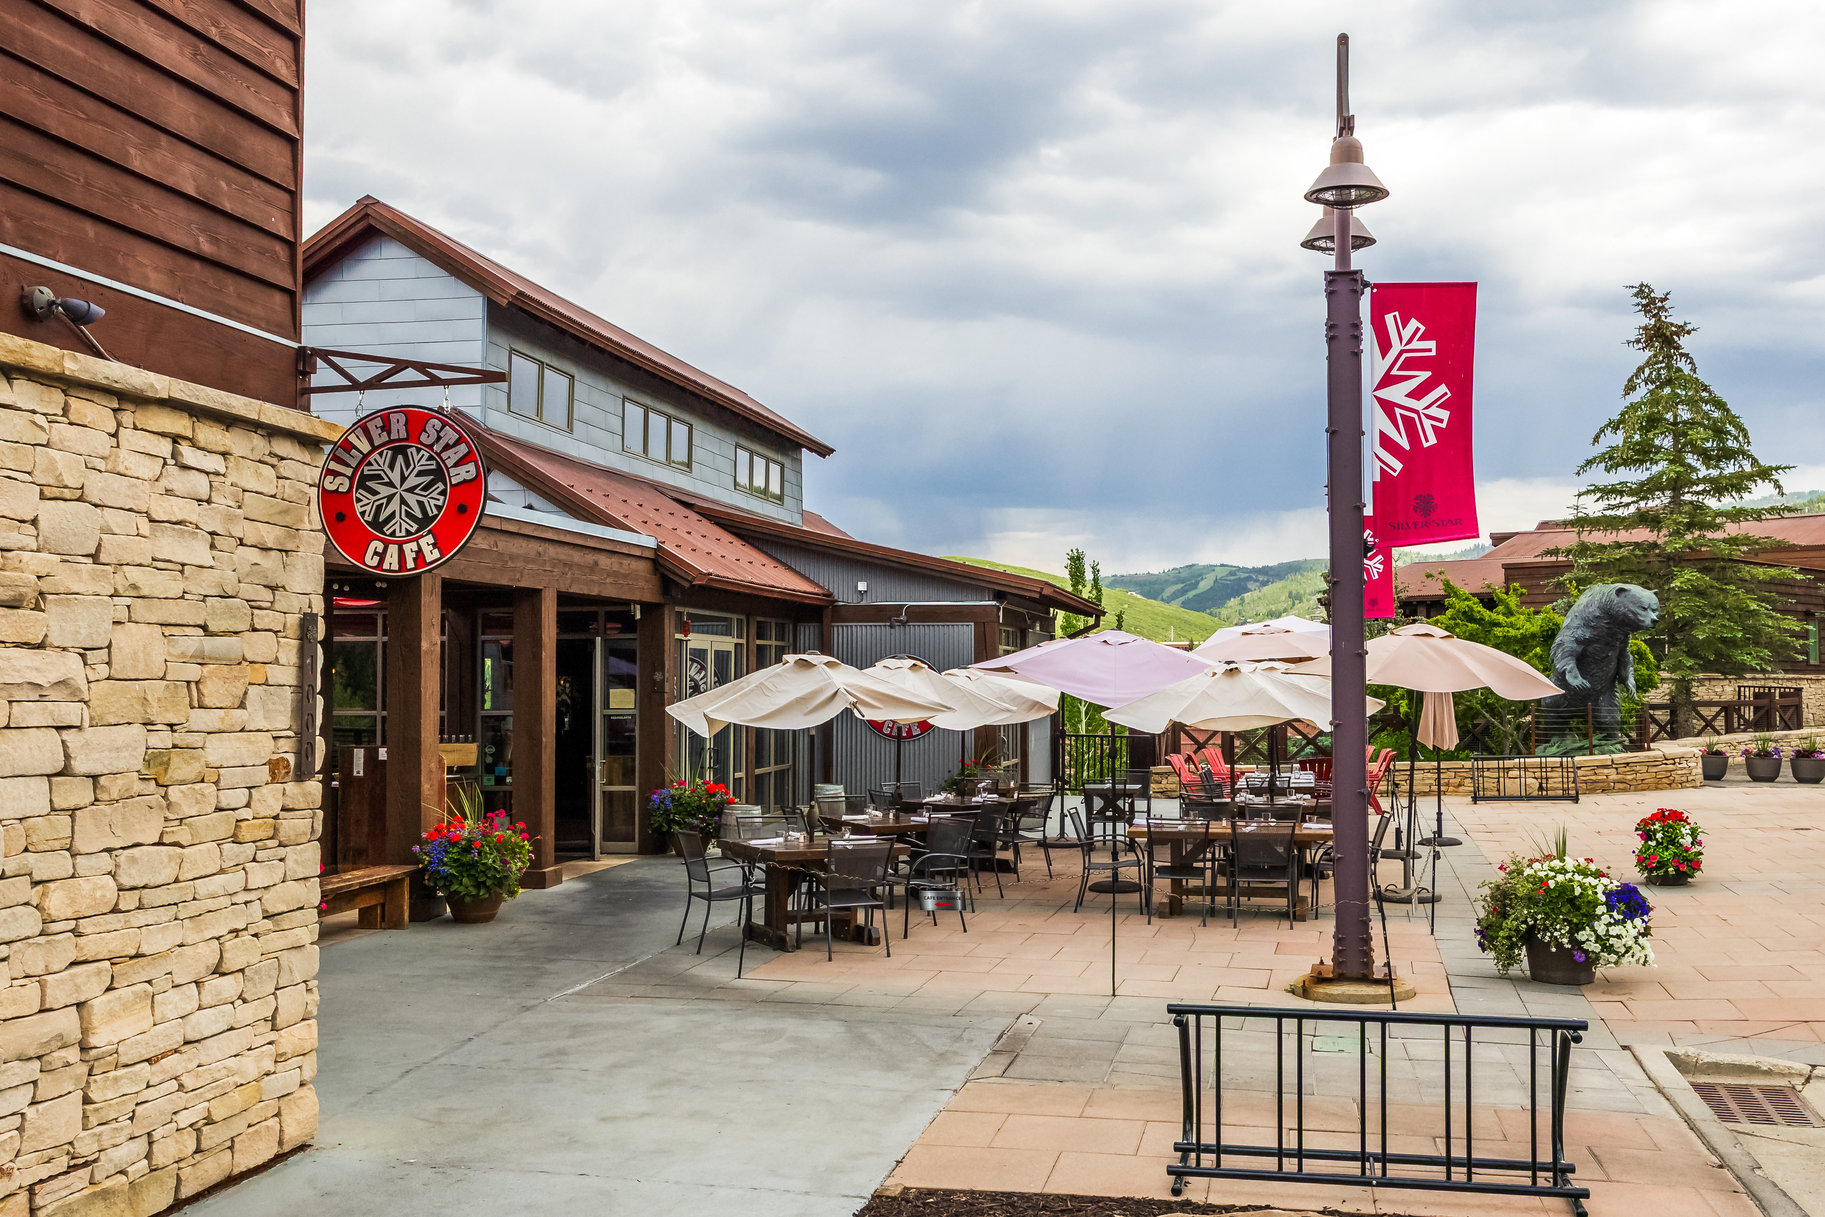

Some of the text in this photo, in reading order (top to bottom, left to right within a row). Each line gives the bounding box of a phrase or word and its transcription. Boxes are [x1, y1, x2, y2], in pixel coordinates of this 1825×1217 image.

[323, 412, 478, 493] SILVER STAR
[1388, 518, 1463, 530] SILVER STAR
[305, 654, 315, 762] 1000
